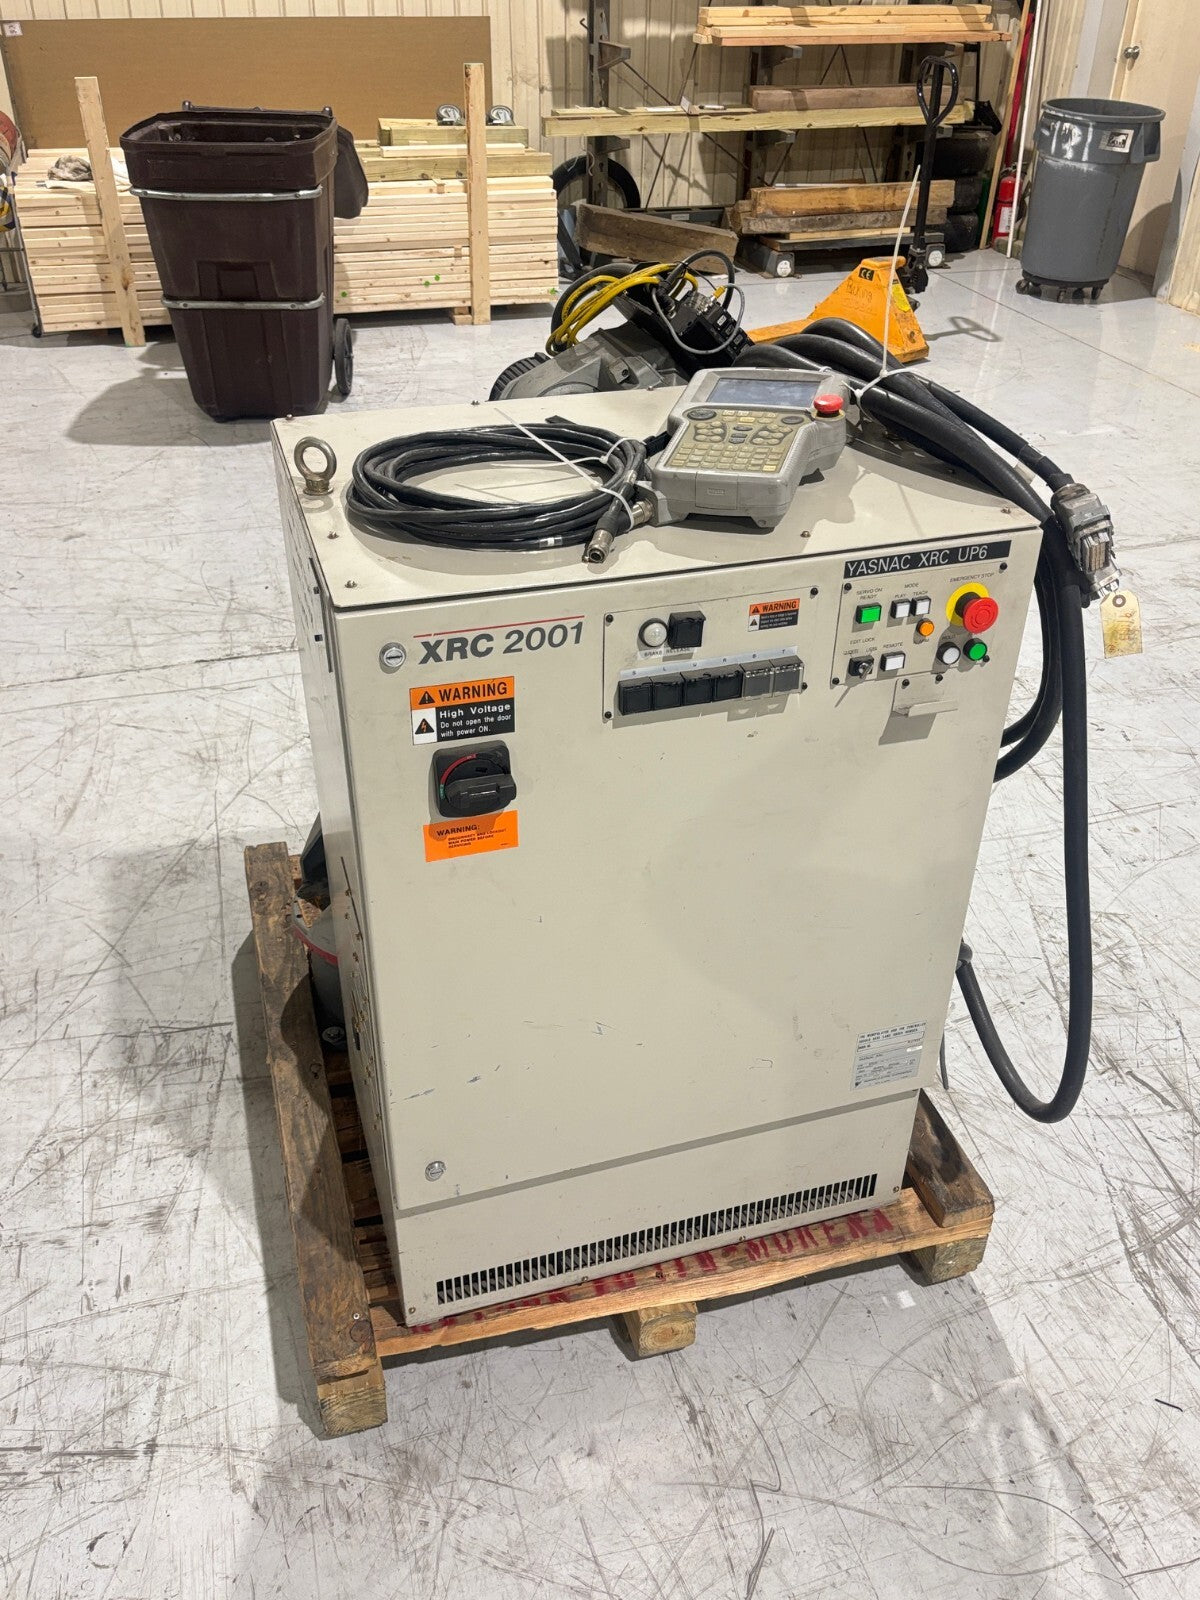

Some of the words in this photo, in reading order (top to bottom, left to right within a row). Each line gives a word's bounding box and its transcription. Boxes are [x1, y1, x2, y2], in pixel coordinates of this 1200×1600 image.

[847, 554, 911, 577] YASNAC
[918, 550, 950, 567] XRC
[957, 545, 988, 562] UP6
[950, 574, 980, 582] EMERGENCY
[762, 600, 797, 612] WARNING
[418, 633, 494, 665] XRC
[503, 621, 583, 654] 2001
[882, 641, 903, 649] REMOTE
[438, 681, 508, 703] WARNING
[439, 708, 464, 719] High
[470, 703, 511, 715] Voltage
[440, 721, 449, 729] Do
[466, 718, 481, 726] open
[497, 714, 512, 722] door
[441, 730, 453, 738] with
[457, 728, 475, 737] power
[479, 725, 491, 733] ON.
[436, 824, 480, 836] WARNING:
